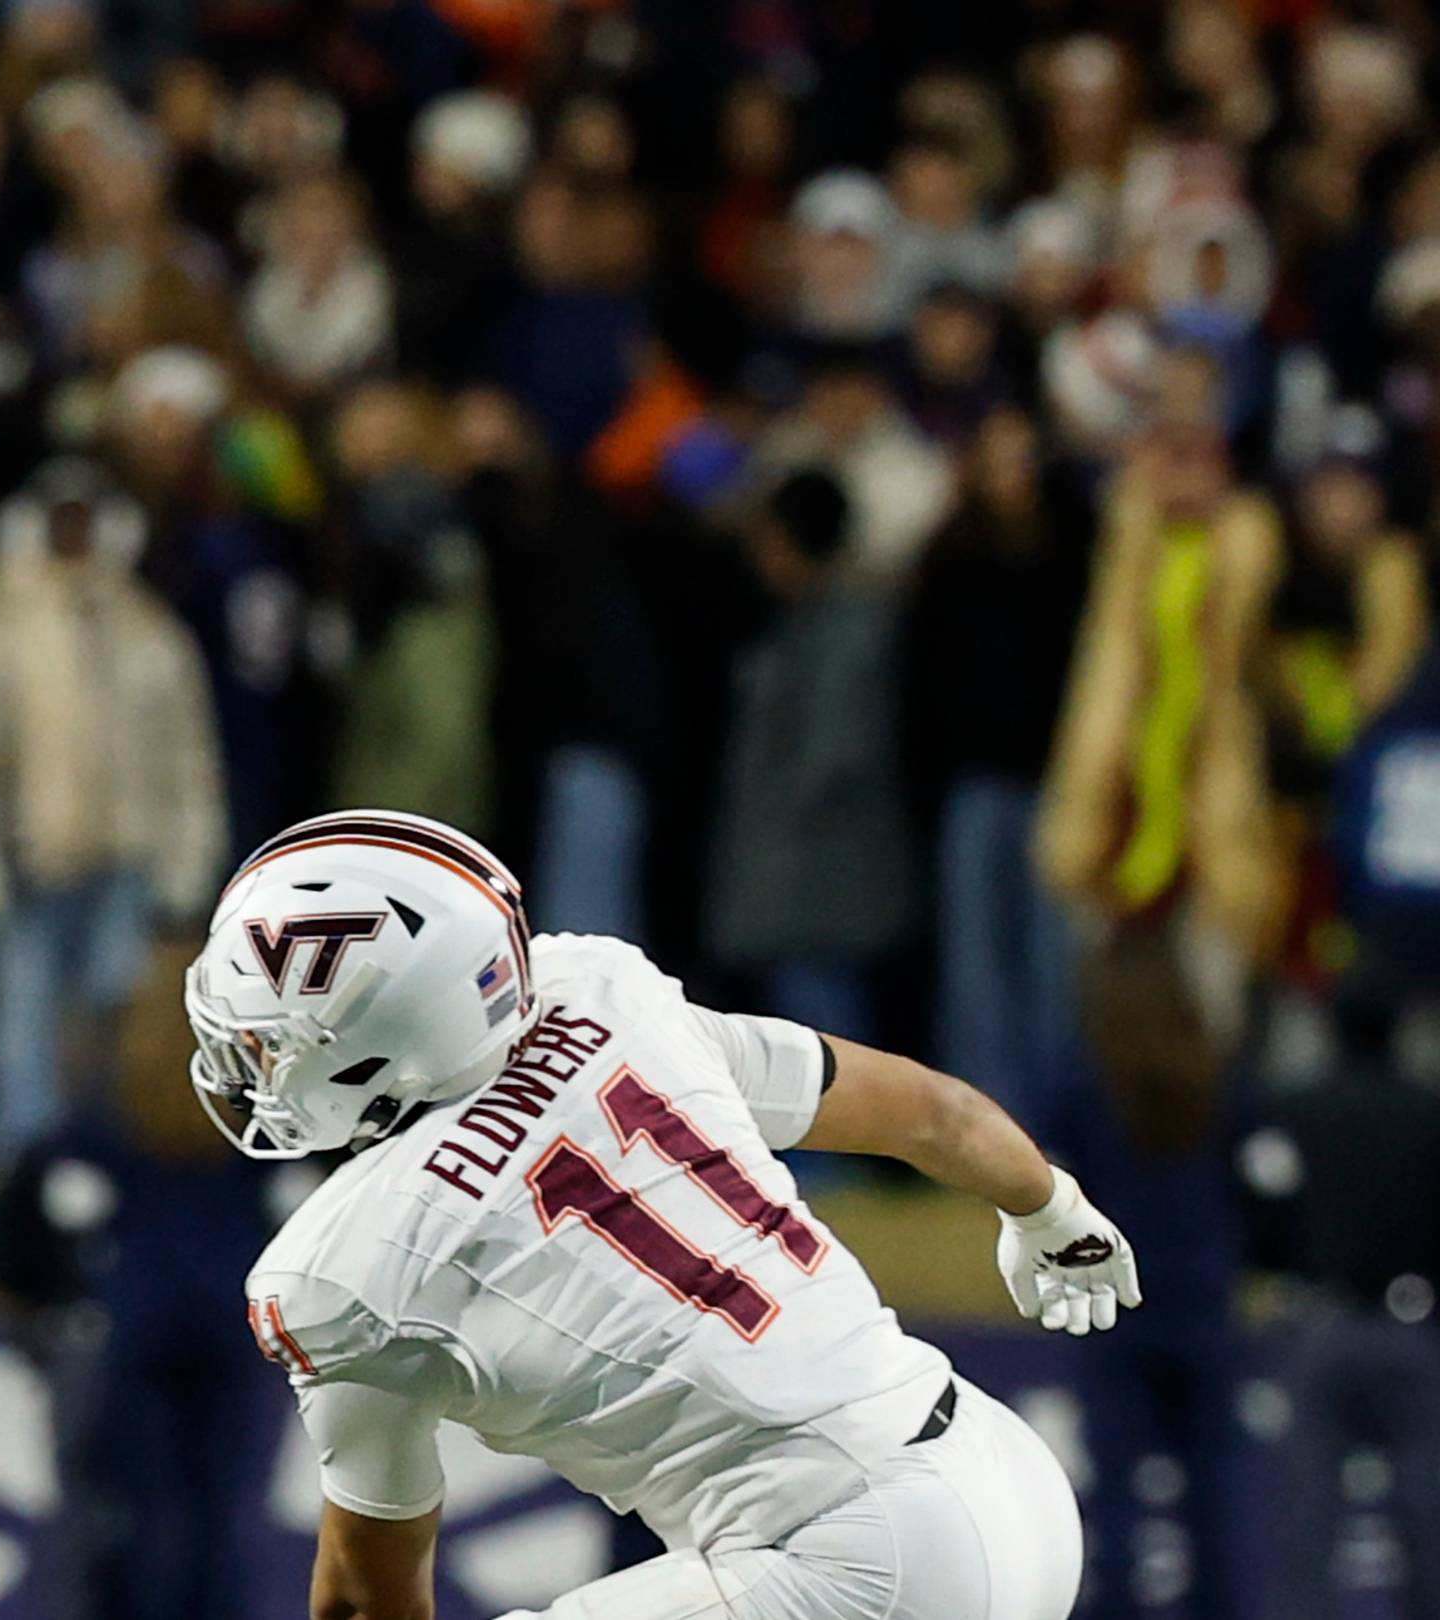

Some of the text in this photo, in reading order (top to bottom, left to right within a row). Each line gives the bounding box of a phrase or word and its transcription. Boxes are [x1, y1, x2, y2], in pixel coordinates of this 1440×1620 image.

[242, 911, 389, 999] VT
[423, 1005, 613, 1200] FLOWERS
[524, 1062, 830, 1345] 11
